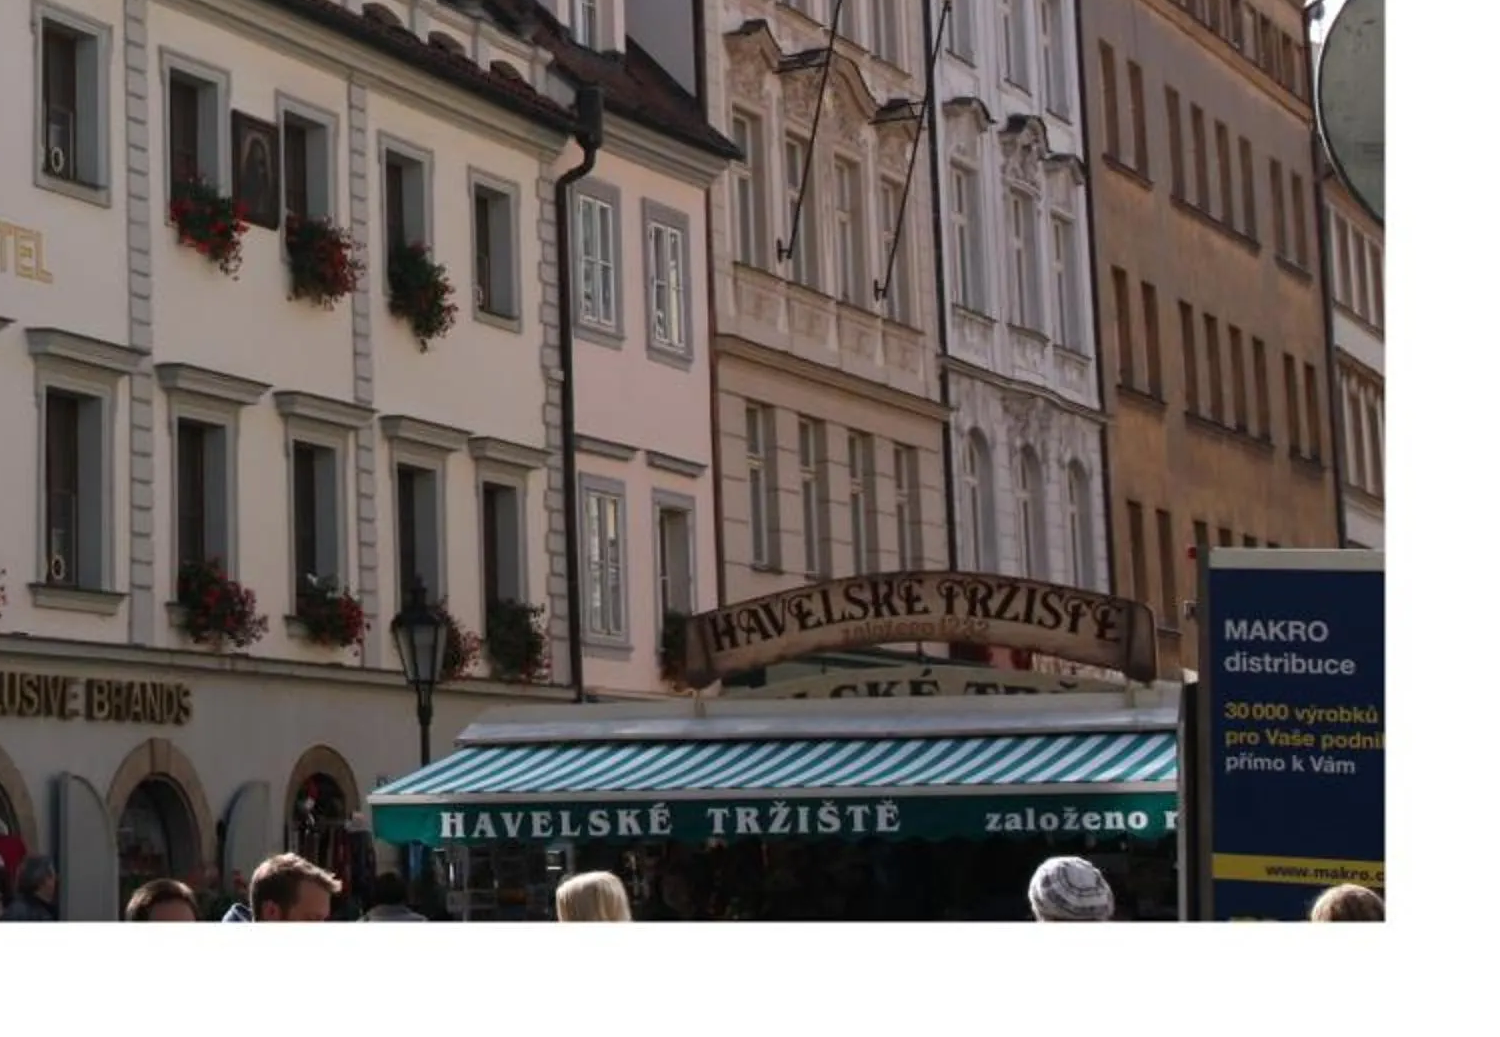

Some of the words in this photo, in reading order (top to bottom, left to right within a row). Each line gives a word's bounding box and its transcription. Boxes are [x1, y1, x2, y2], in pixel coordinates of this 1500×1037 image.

[1224, 619, 1329, 642] MAKRO
[1224, 652, 1357, 675] distribuce
[85, 678, 192, 725] BRANDS
[1294, 704, 1379, 724] výrobků
[1225, 730, 1260, 748] pro
[1265, 728, 1316, 747] Vaše
[1225, 751, 1286, 774] přímo
[1291, 755, 1305, 772] k
[1309, 755, 1356, 774] Vám
[439, 803, 673, 838] HAVELSKÉ
[707, 799, 901, 835] TRŽIŠTĚ
[984, 807, 1149, 832] založeno
